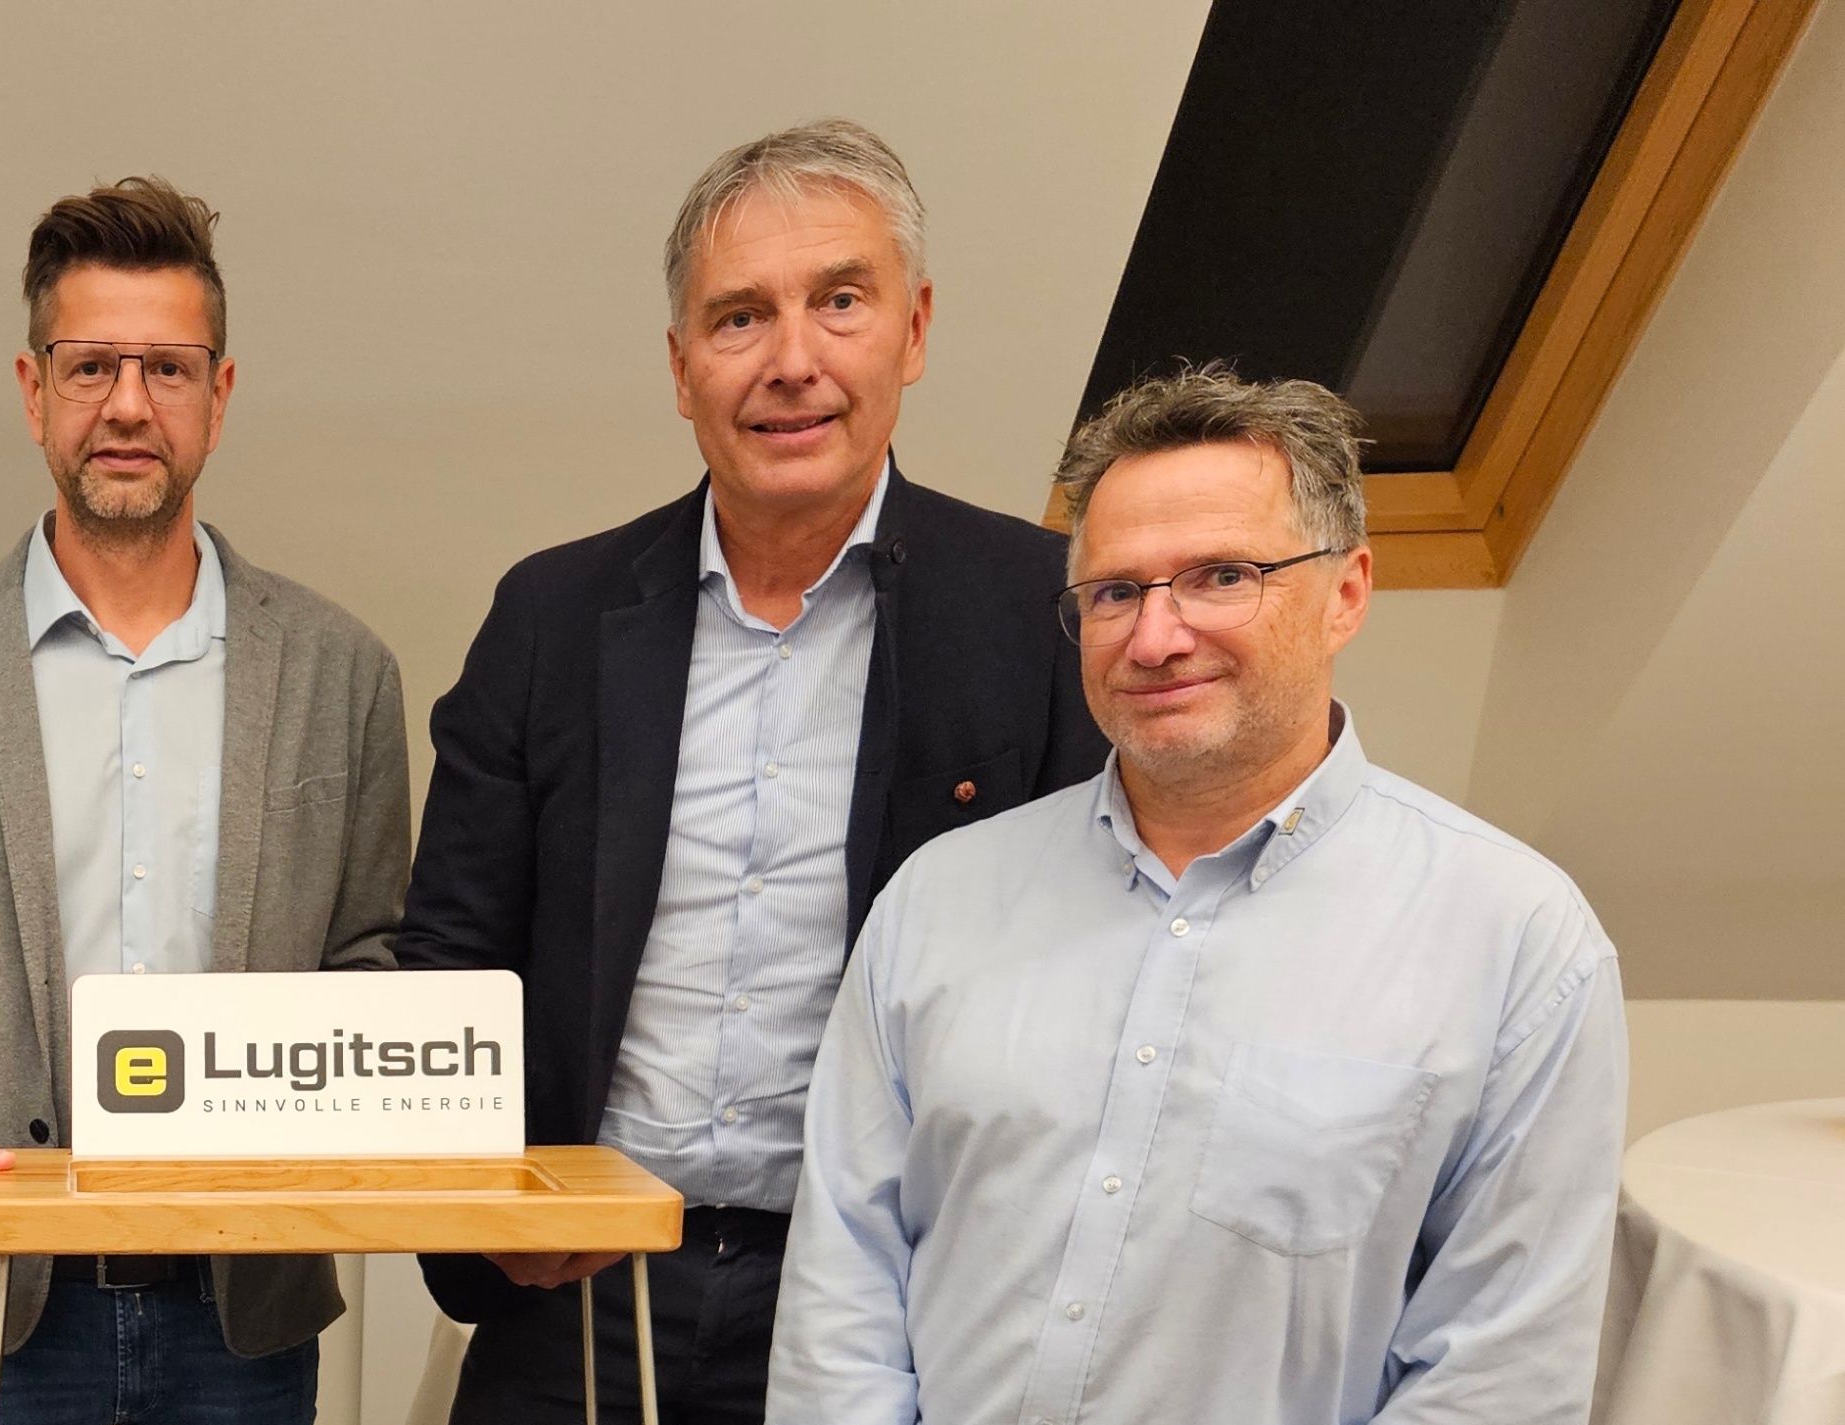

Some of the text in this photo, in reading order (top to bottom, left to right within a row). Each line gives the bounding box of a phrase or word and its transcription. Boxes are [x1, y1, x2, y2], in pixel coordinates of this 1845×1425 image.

[203, 1027, 502, 1091] Lugitsch
[203, 1096, 503, 1113] SINNVOLLE ENERGIE
